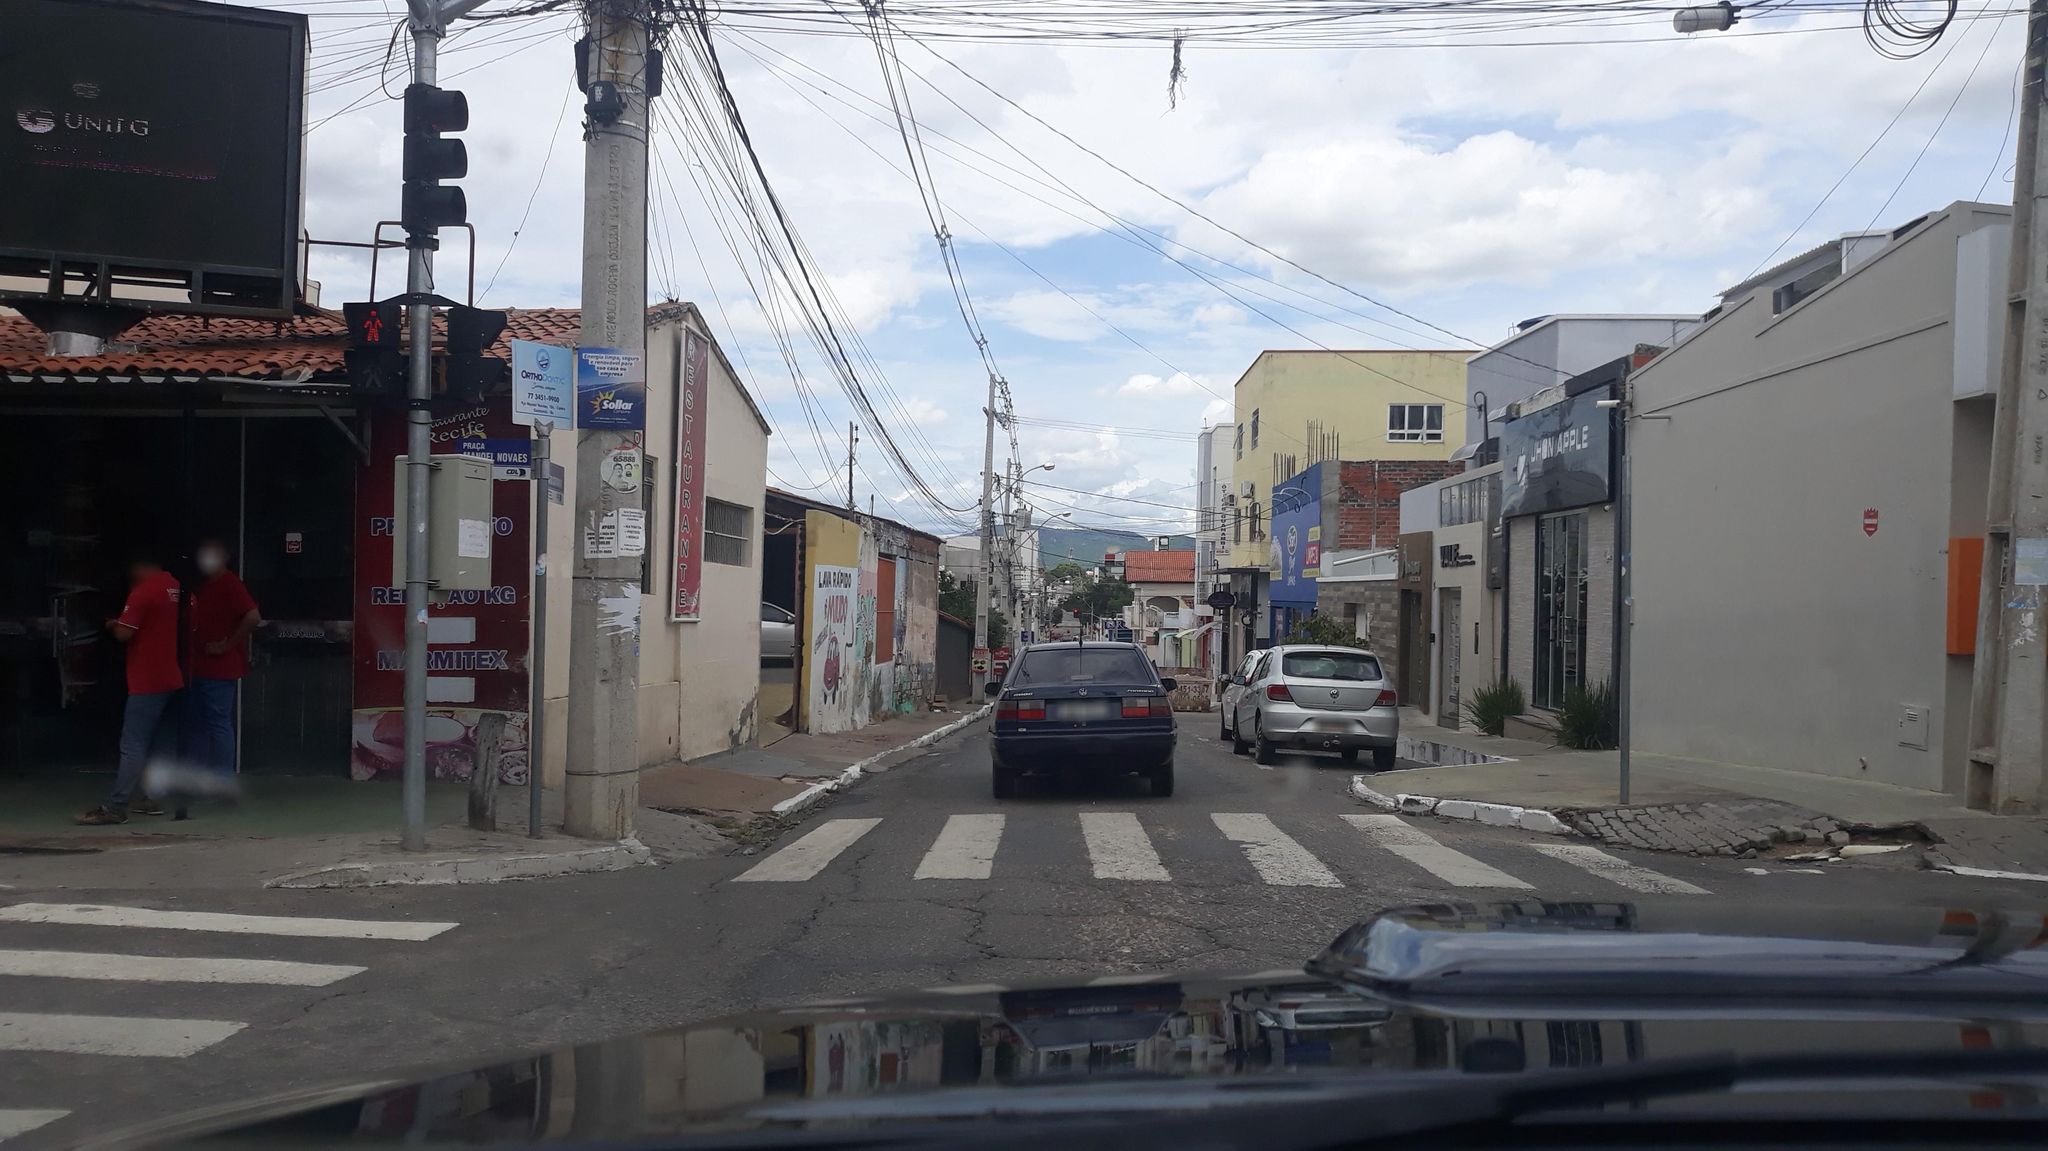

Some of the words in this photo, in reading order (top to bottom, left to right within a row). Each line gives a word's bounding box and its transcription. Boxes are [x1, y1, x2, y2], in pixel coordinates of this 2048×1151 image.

[601, 399, 634, 410] Sollar
[429, 420, 485, 443] Recife
[1556, 425, 1589, 455] APPLE
[463, 442, 486, 451] PRAÇA
[496, 452, 528, 463] NOVAES
[678, 338, 696, 609] RESTAURANTE
[818, 571, 832, 588] LAVA
[832, 568, 852, 589] RÁPIDO
[484, 586, 517, 605] KG
